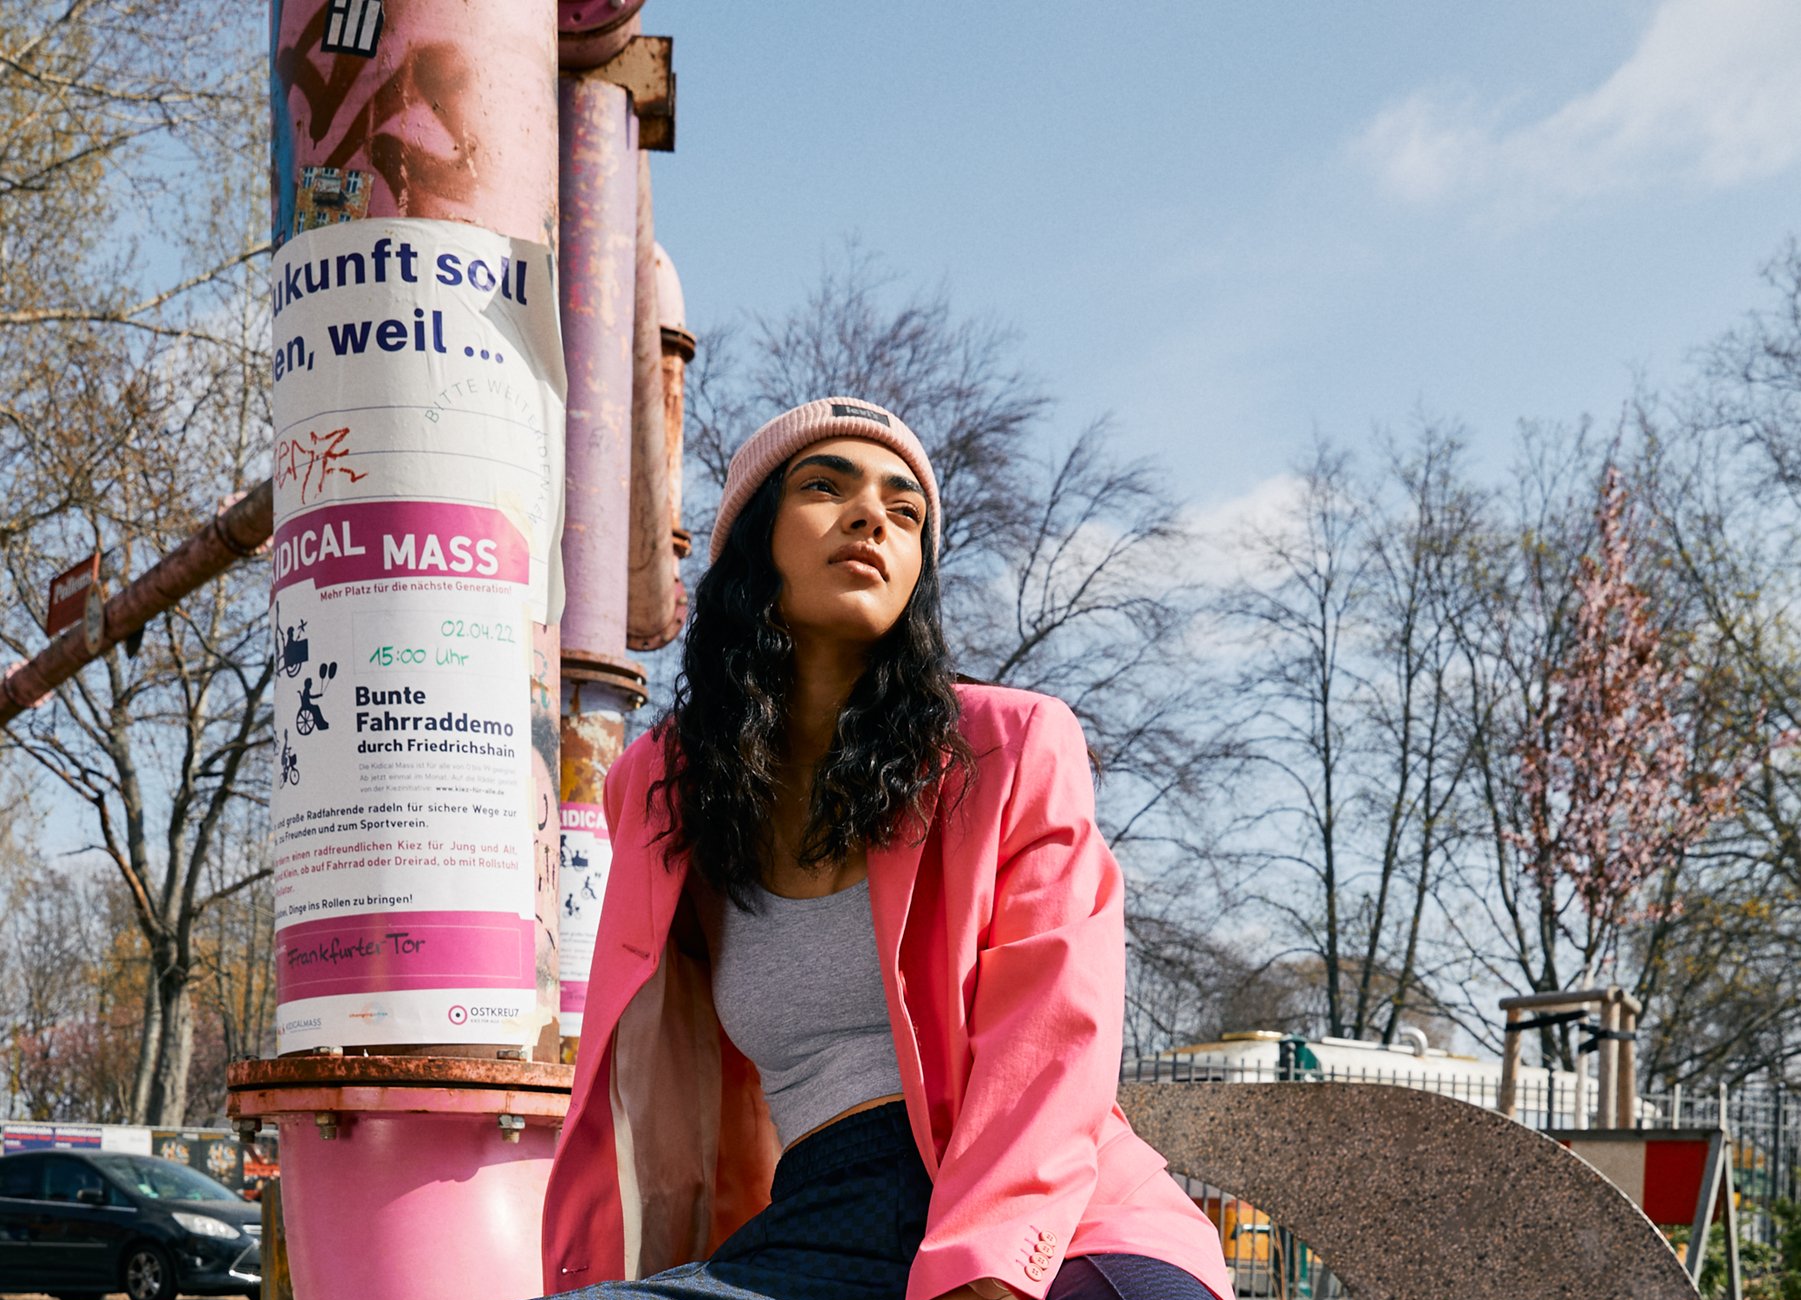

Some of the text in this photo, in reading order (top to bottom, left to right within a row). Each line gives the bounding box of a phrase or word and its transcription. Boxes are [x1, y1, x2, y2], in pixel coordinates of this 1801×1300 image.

[435, 252, 528, 306] soll
[274, 334, 315, 383] en,
[327, 307, 447, 356] weil
[424, 378, 479, 424] BITTE
[382, 533, 499, 576] MASS
[320, 581, 512, 602] Mehr Platz für die nächste Generation!
[440, 620, 516, 644] 02.04.22
[369, 645, 472, 667] 15:00 Uhr
[355, 686, 426, 707] Bunte
[356, 711, 514, 737] Fahrraddemo
[357, 738, 515, 759] durch Friedrichshain
[286, 813, 305, 828] große
[306, 804, 365, 820] Radfahrende
[368, 802, 403, 814] radeln
[407, 802, 423, 813] für
[428, 802, 468, 814] sichere
[472, 803, 500, 818] Wege
[503, 808, 517, 818] zur
[560, 809, 608, 830] IDICA
[285, 827, 317, 841] Freunden
[318, 822, 335, 834] und
[337, 821, 358, 832] zum
[360, 818, 429, 832] Sportverein.
[313, 841, 393, 857] radfreundlichen
[397, 840, 423, 851] Kiez
[427, 839, 444, 851] für
[450, 840, 476, 854] Jung
[480, 843, 499, 853] und
[300, 864, 310, 875] ob
[311, 862, 325, 873] auf
[326, 857, 365, 871] Fahrrad
[367, 856, 392, 867] oder
[394, 855, 440, 867] Dreirad,
[443, 856, 456, 866] ob
[458, 857, 476, 867] mit
[478, 857, 519, 870] Rollstuhl
[289, 904, 307, 916] Dinge
[308, 900, 320, 911] ins
[321, 897, 351, 909] Rollen
[353, 896, 365, 906] zu
[366, 893, 413, 907] bringen!
[287, 932, 426, 969] Frankfurter Tor
